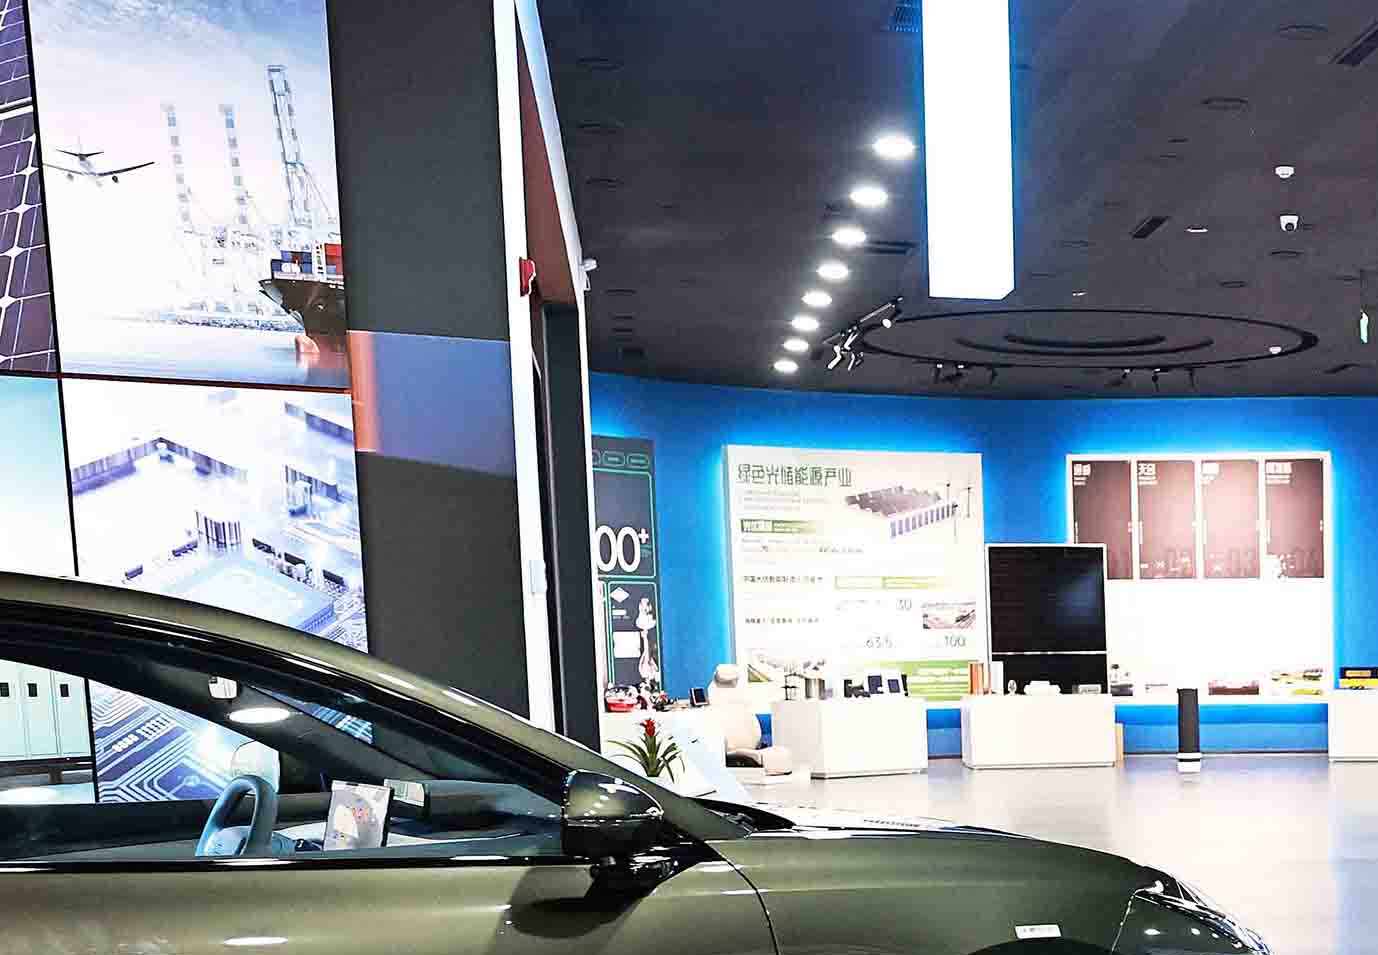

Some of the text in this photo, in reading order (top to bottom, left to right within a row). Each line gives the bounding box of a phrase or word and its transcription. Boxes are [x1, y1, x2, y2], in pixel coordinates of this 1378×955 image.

[738, 463, 852, 487] 绿色光储能源产业
